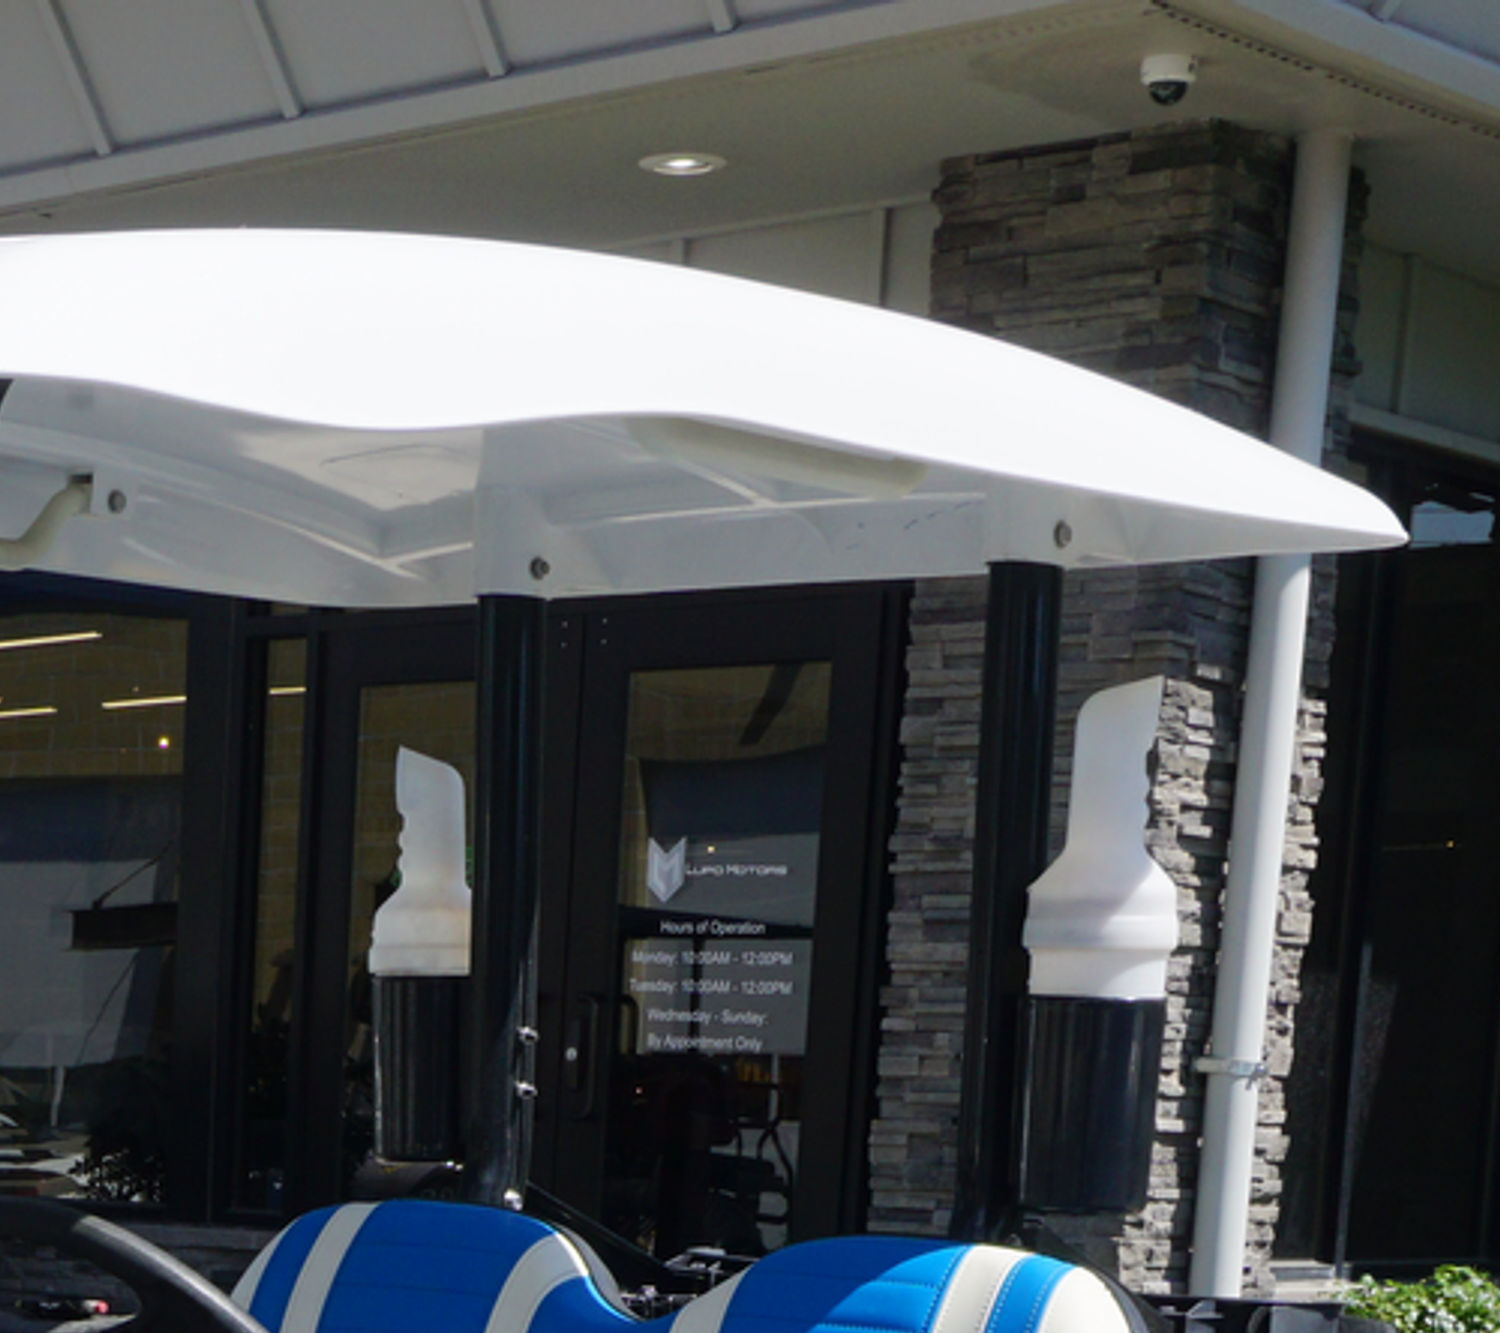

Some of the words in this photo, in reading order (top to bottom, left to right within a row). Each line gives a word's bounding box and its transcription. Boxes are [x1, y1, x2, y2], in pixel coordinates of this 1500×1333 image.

[660, 920, 694, 935] Hours
[696, 919, 709, 934] of
[711, 920, 766, 936] Operation
[647, 1008, 711, 1025] Wednesday
[647, 1033, 662, 1049] By
[663, 1034, 733, 1051] Appointment
[735, 1035, 763, 1052] Only
